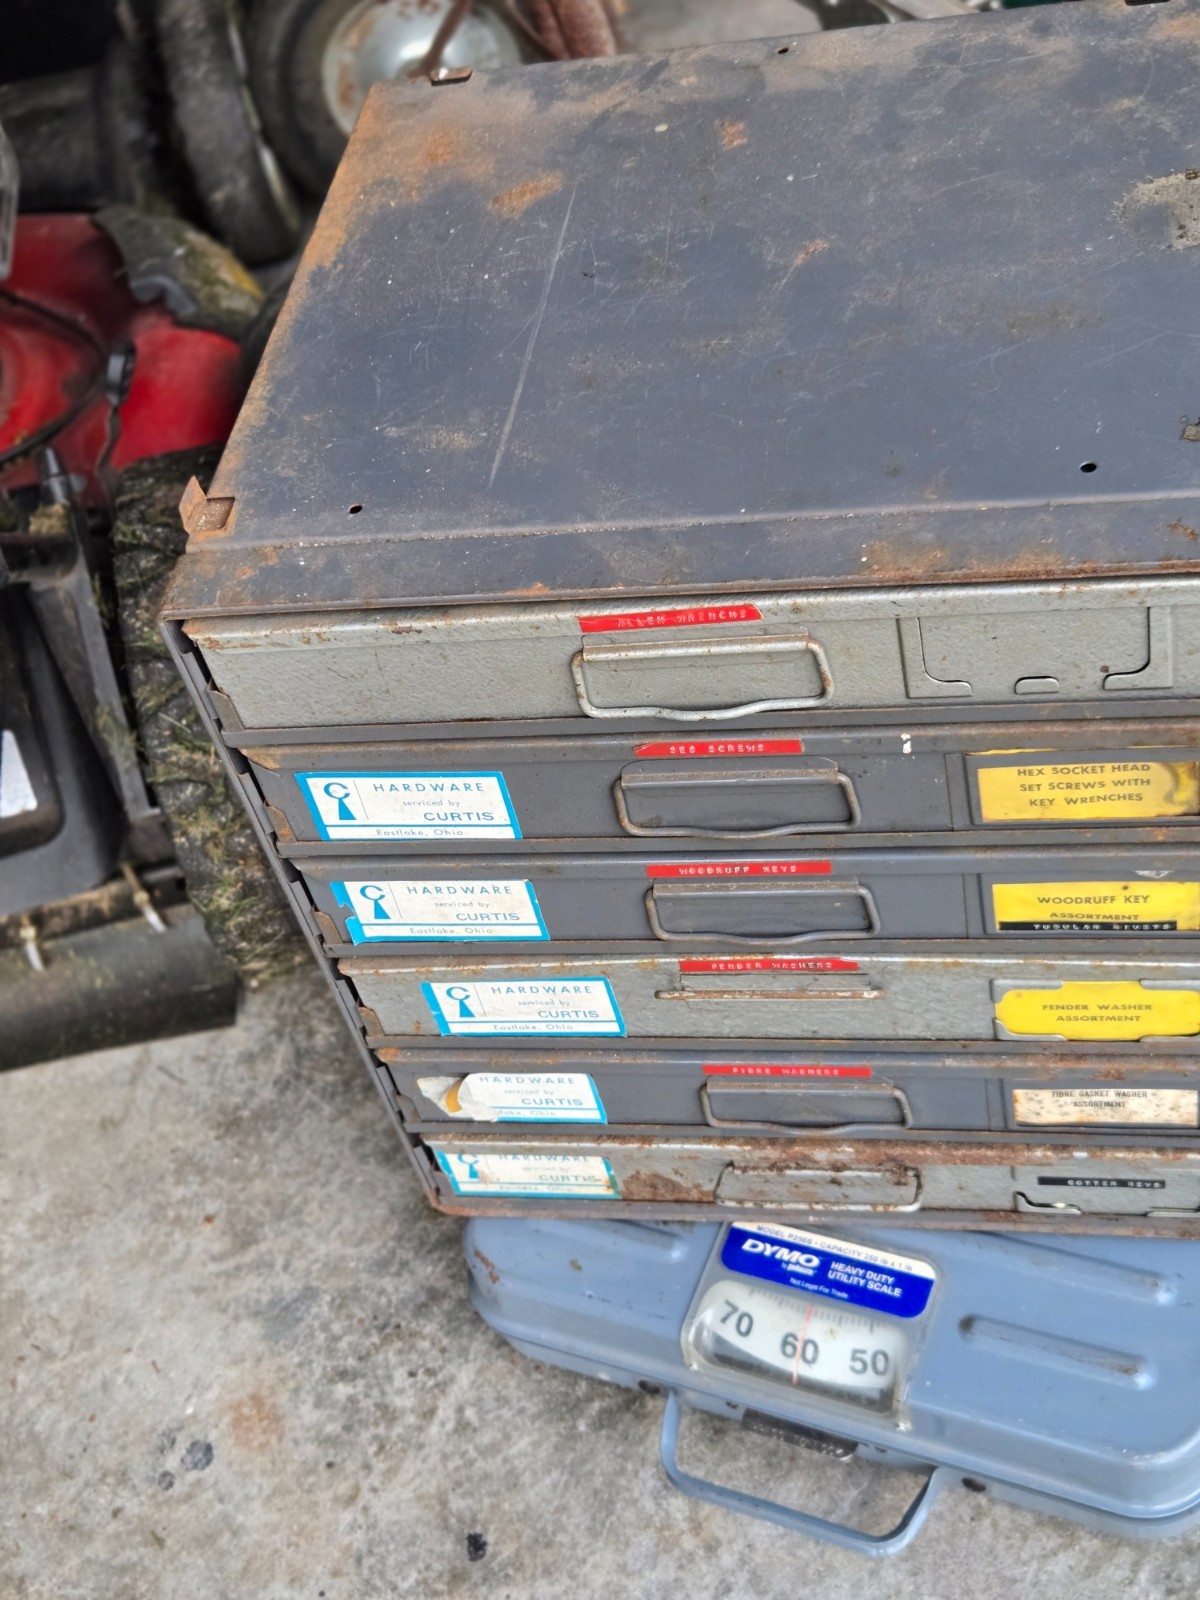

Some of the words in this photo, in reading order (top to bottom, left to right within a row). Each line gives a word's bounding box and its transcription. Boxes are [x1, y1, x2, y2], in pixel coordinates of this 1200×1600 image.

[708, 743, 764, 753] SCREWS
[1017, 768, 1045, 777] HEX
[1051, 765, 1106, 775] SOCKET
[1111, 764, 1151, 773] HEAD
[373, 782, 484, 792] HARDWARE
[1020, 784, 1042, 792] SET
[1048, 781, 1105, 790] SCREWS
[1112, 779, 1151, 787] WITH
[402, 799, 444, 807] serviced
[448, 799, 461, 809] by
[1029, 798, 1056, 807] KEY
[1064, 793, 1143, 805] WRENCHES
[423, 812, 495, 821] CURTIS
[376, 829, 429, 837] Eastlake,
[679, 865, 750, 875] WOODRUFF
[762, 865, 797, 873] KEYS
[407, 885, 513, 895] HARDWARE
[1037, 896, 1116, 904] WOODRUFF
[1124, 895, 1150, 904] KEY
[478, 901, 490, 909] by
[456, 912, 520, 921] CURTIS
[1049, 912, 1140, 920] ASSORTMENT
[410, 927, 460, 935] Eastlake,
[712, 962, 762, 970] FENDER
[771, 961, 832, 969] WASHERS
[491, 985, 593, 994] HARDWARE
[559, 999, 570, 1008] by
[538, 1010, 600, 1019] CURTIS
[479, 1076, 575, 1085] HARDWARE
[1052, 1090, 1073, 1098] FIBRE
[1079, 1090, 1109, 1098] GASKET
[1114, 1090, 1148, 1098] WASHER
[521, 1098, 584, 1106] CURTIS
[539, 1174, 598, 1183] CURTIS
[756, 1225, 786, 1239] MODEL
[820, 1241, 862, 1258] CAPACITY
[741, 1238, 820, 1268] DYMO
[830, 1261, 865, 1277] HEAVY
[866, 1271, 895, 1285] DUTY
[827, 1270, 866, 1287] UTILITY
[867, 1280, 903, 1297] SCALE
[720, 1299, 754, 1338] 70
[780, 1332, 819, 1365] 60
[849, 1348, 889, 1376] 50
